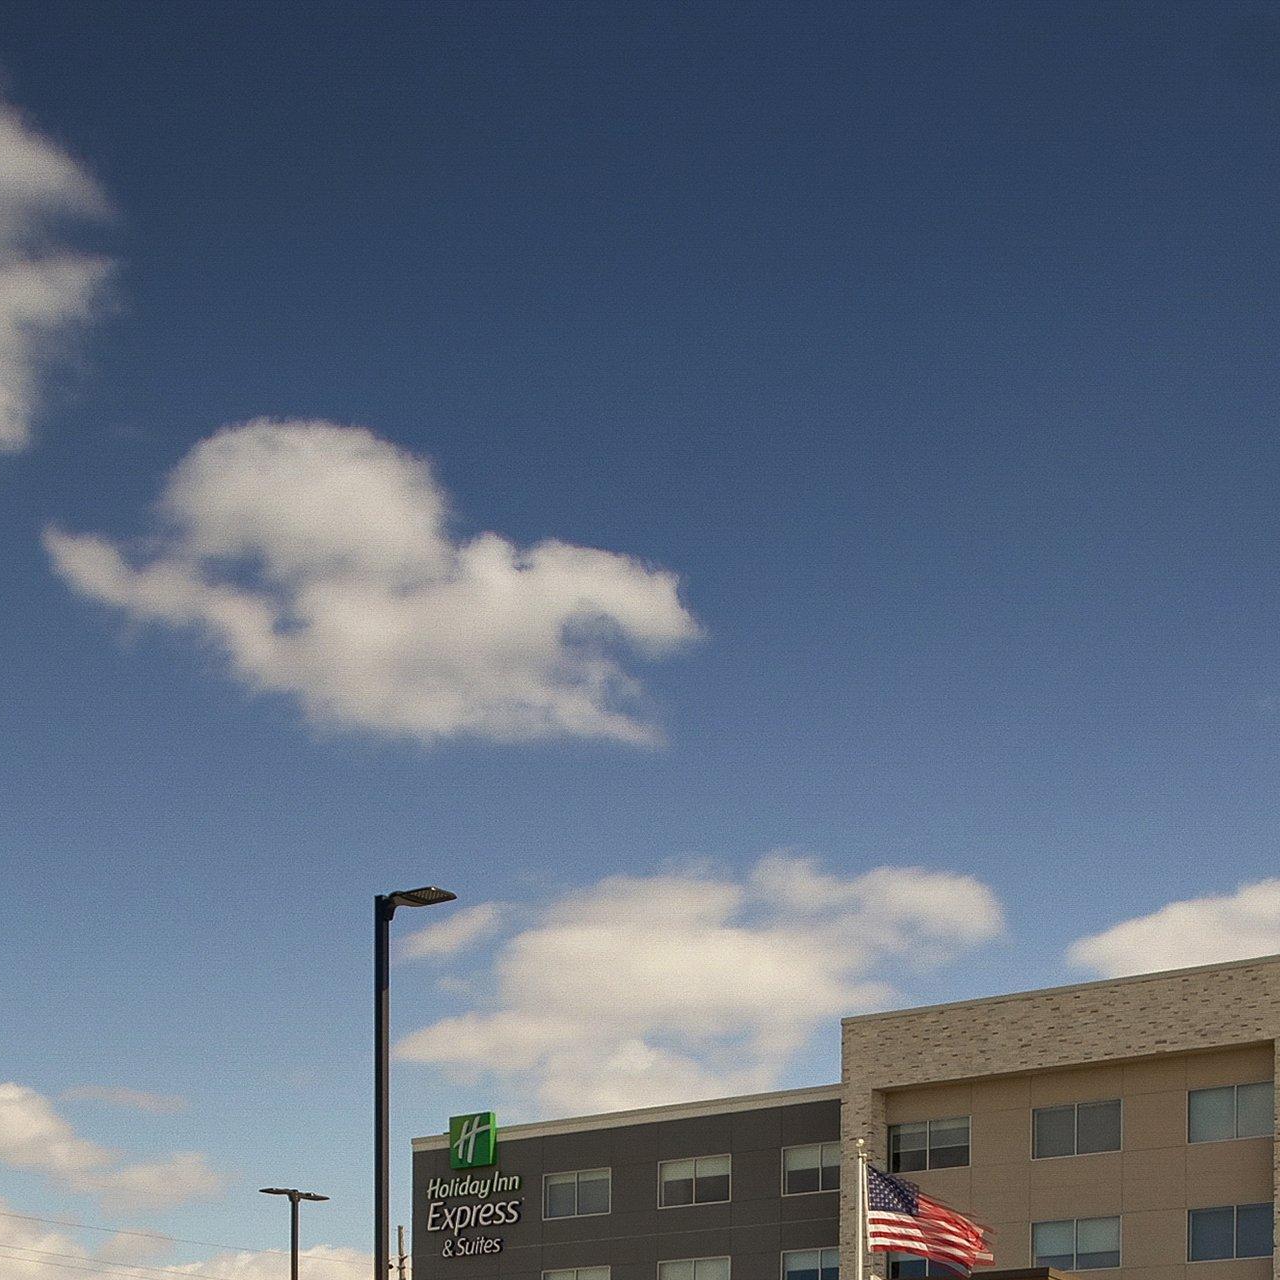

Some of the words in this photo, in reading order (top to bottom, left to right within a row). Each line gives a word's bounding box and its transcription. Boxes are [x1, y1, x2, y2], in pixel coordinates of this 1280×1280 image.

[427, 1174, 491, 1199] Holiday
[493, 1171, 520, 1193] Inn
[427, 1200, 520, 1237] Express
[442, 1239, 454, 1258] &
[456, 1236, 502, 1257] Suites
